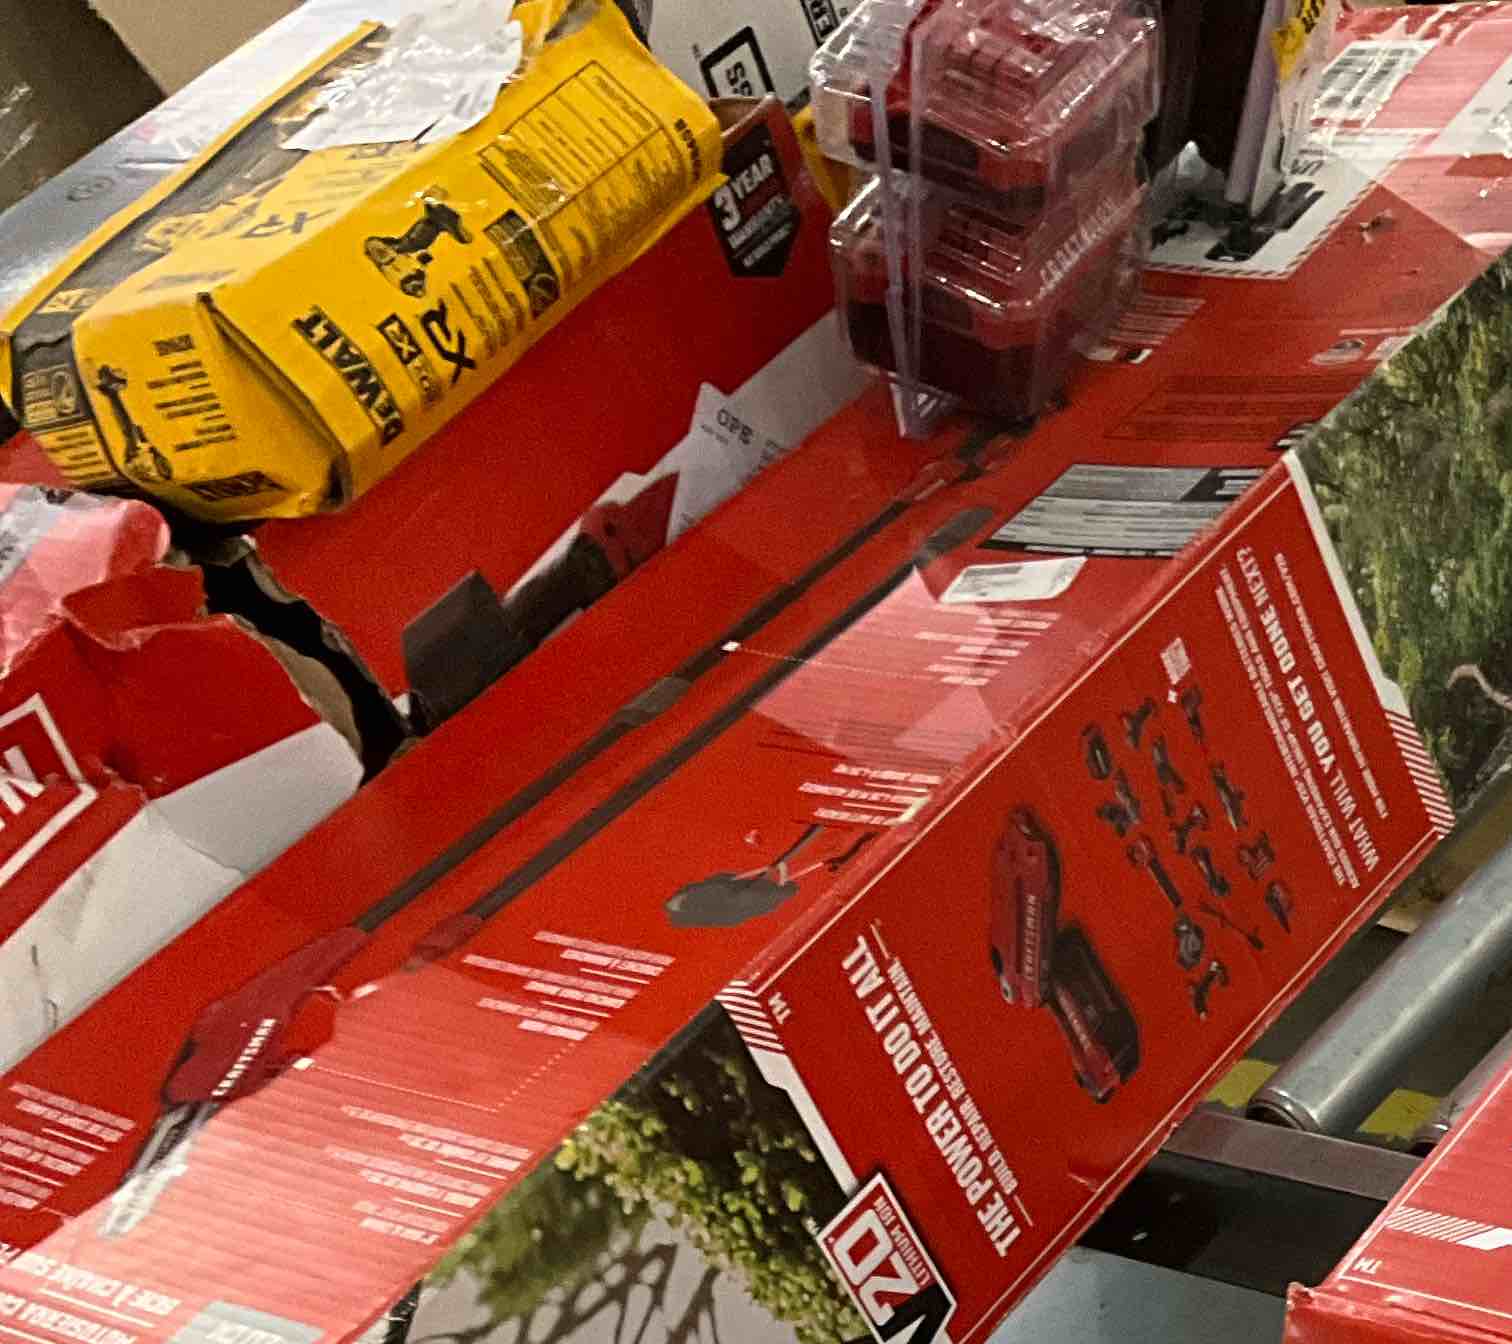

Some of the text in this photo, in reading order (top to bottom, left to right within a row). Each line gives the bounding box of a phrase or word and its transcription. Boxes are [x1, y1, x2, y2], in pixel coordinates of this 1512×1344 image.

[711, 153, 774, 233] 3 YEAR
[291, 304, 405, 447] DEWALT
[419, 296, 478, 388] XR
[1235, 545, 1379, 871] WHAT WILL YOU GET DONE NEXT?
[767, 991, 792, 1025] TM
[841, 934, 1022, 1256] THE POWER TO DO IT ALL
[885, 955, 1017, 1194] BUILD. REPAIR. RESTORE. MAINTAIN.
[872, 1194, 931, 1287] LITHIUM ION
